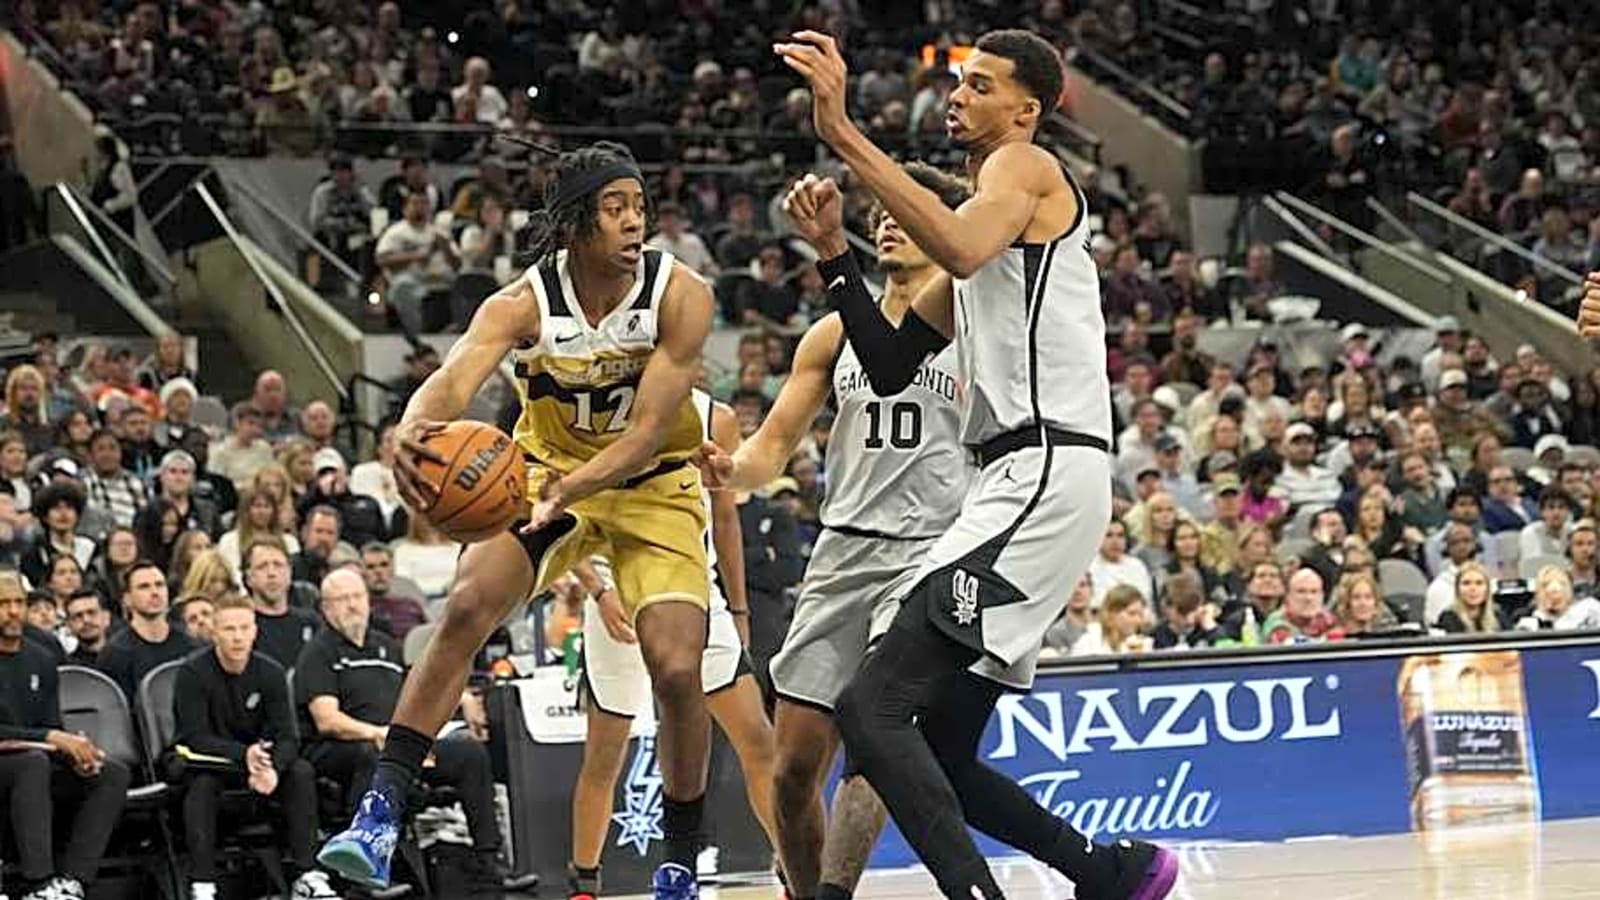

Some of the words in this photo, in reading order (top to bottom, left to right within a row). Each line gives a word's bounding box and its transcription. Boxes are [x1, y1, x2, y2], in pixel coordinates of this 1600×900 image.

[572, 386, 636, 432] 12
[865, 401, 922, 449] 10
[546, 705, 586, 718] GAT
[1018, 761, 1220, 835] Tequila
